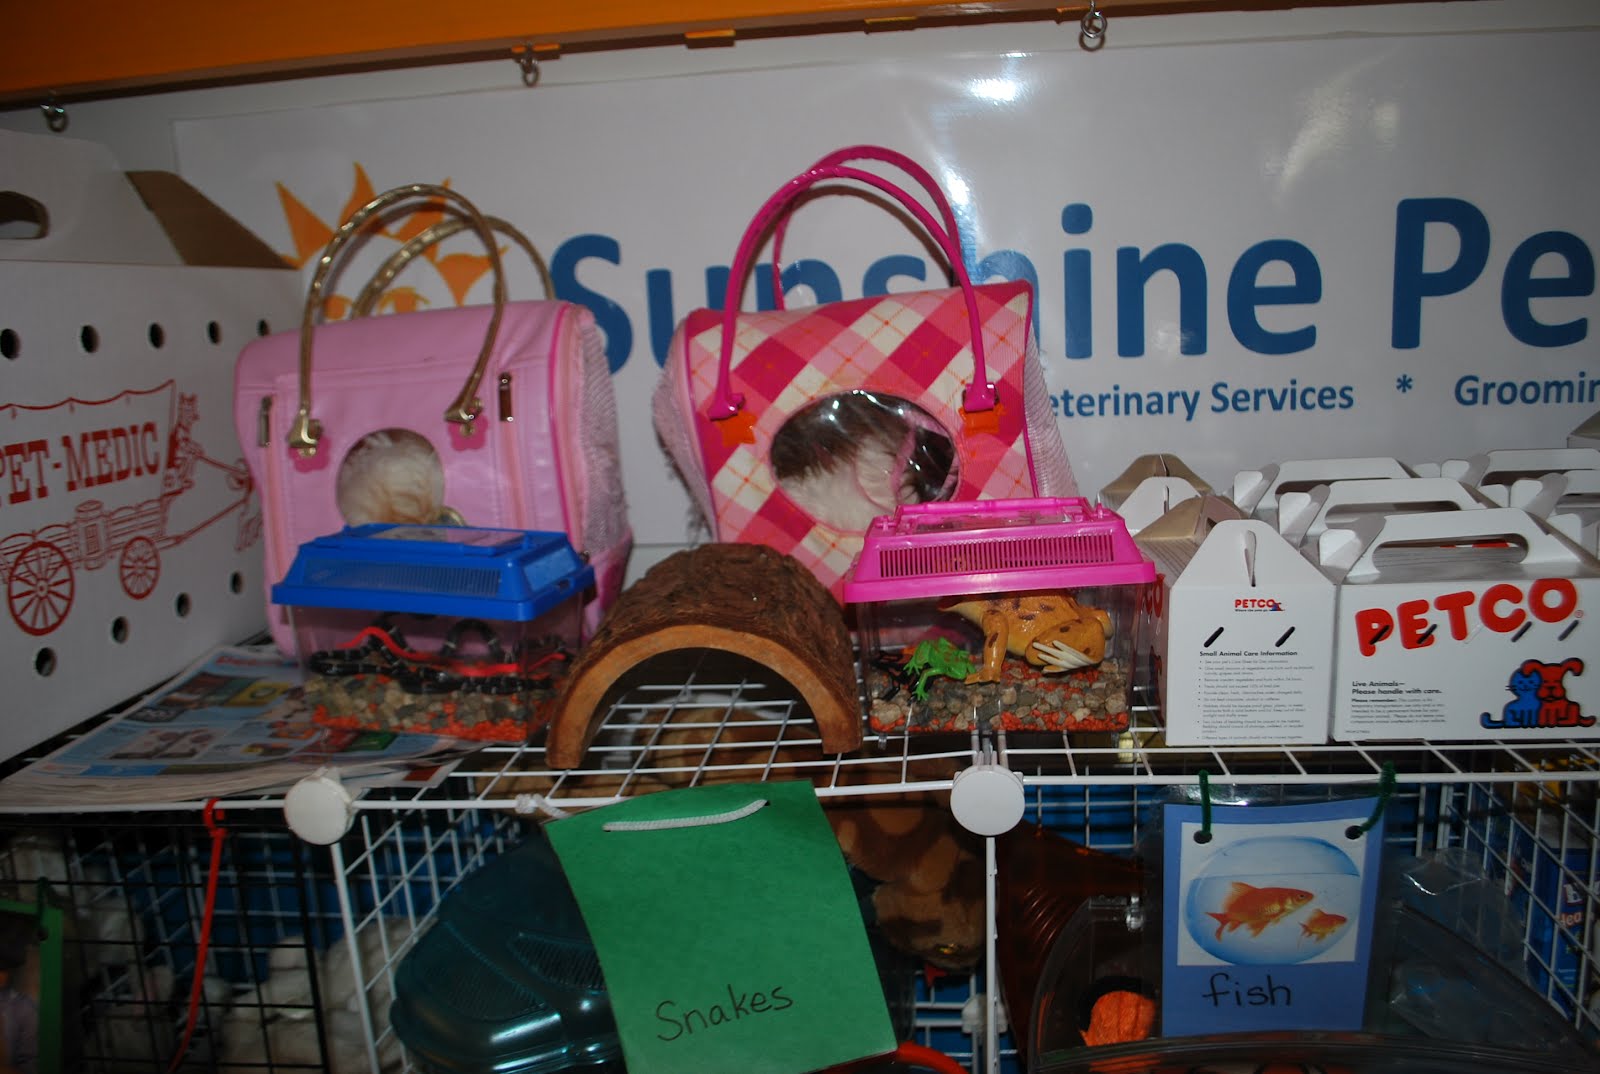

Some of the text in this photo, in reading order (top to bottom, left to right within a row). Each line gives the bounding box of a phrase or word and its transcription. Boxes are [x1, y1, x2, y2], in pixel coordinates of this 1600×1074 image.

[1391, 197, 1596, 349] Pe
[1211, 380, 1354, 413] Services
[1235, 599, 1275, 608] PETCO
[1355, 578, 1577, 656] PETCO
[655, 983, 794, 1042] Snakes
[1202, 972, 1292, 1008] fish
